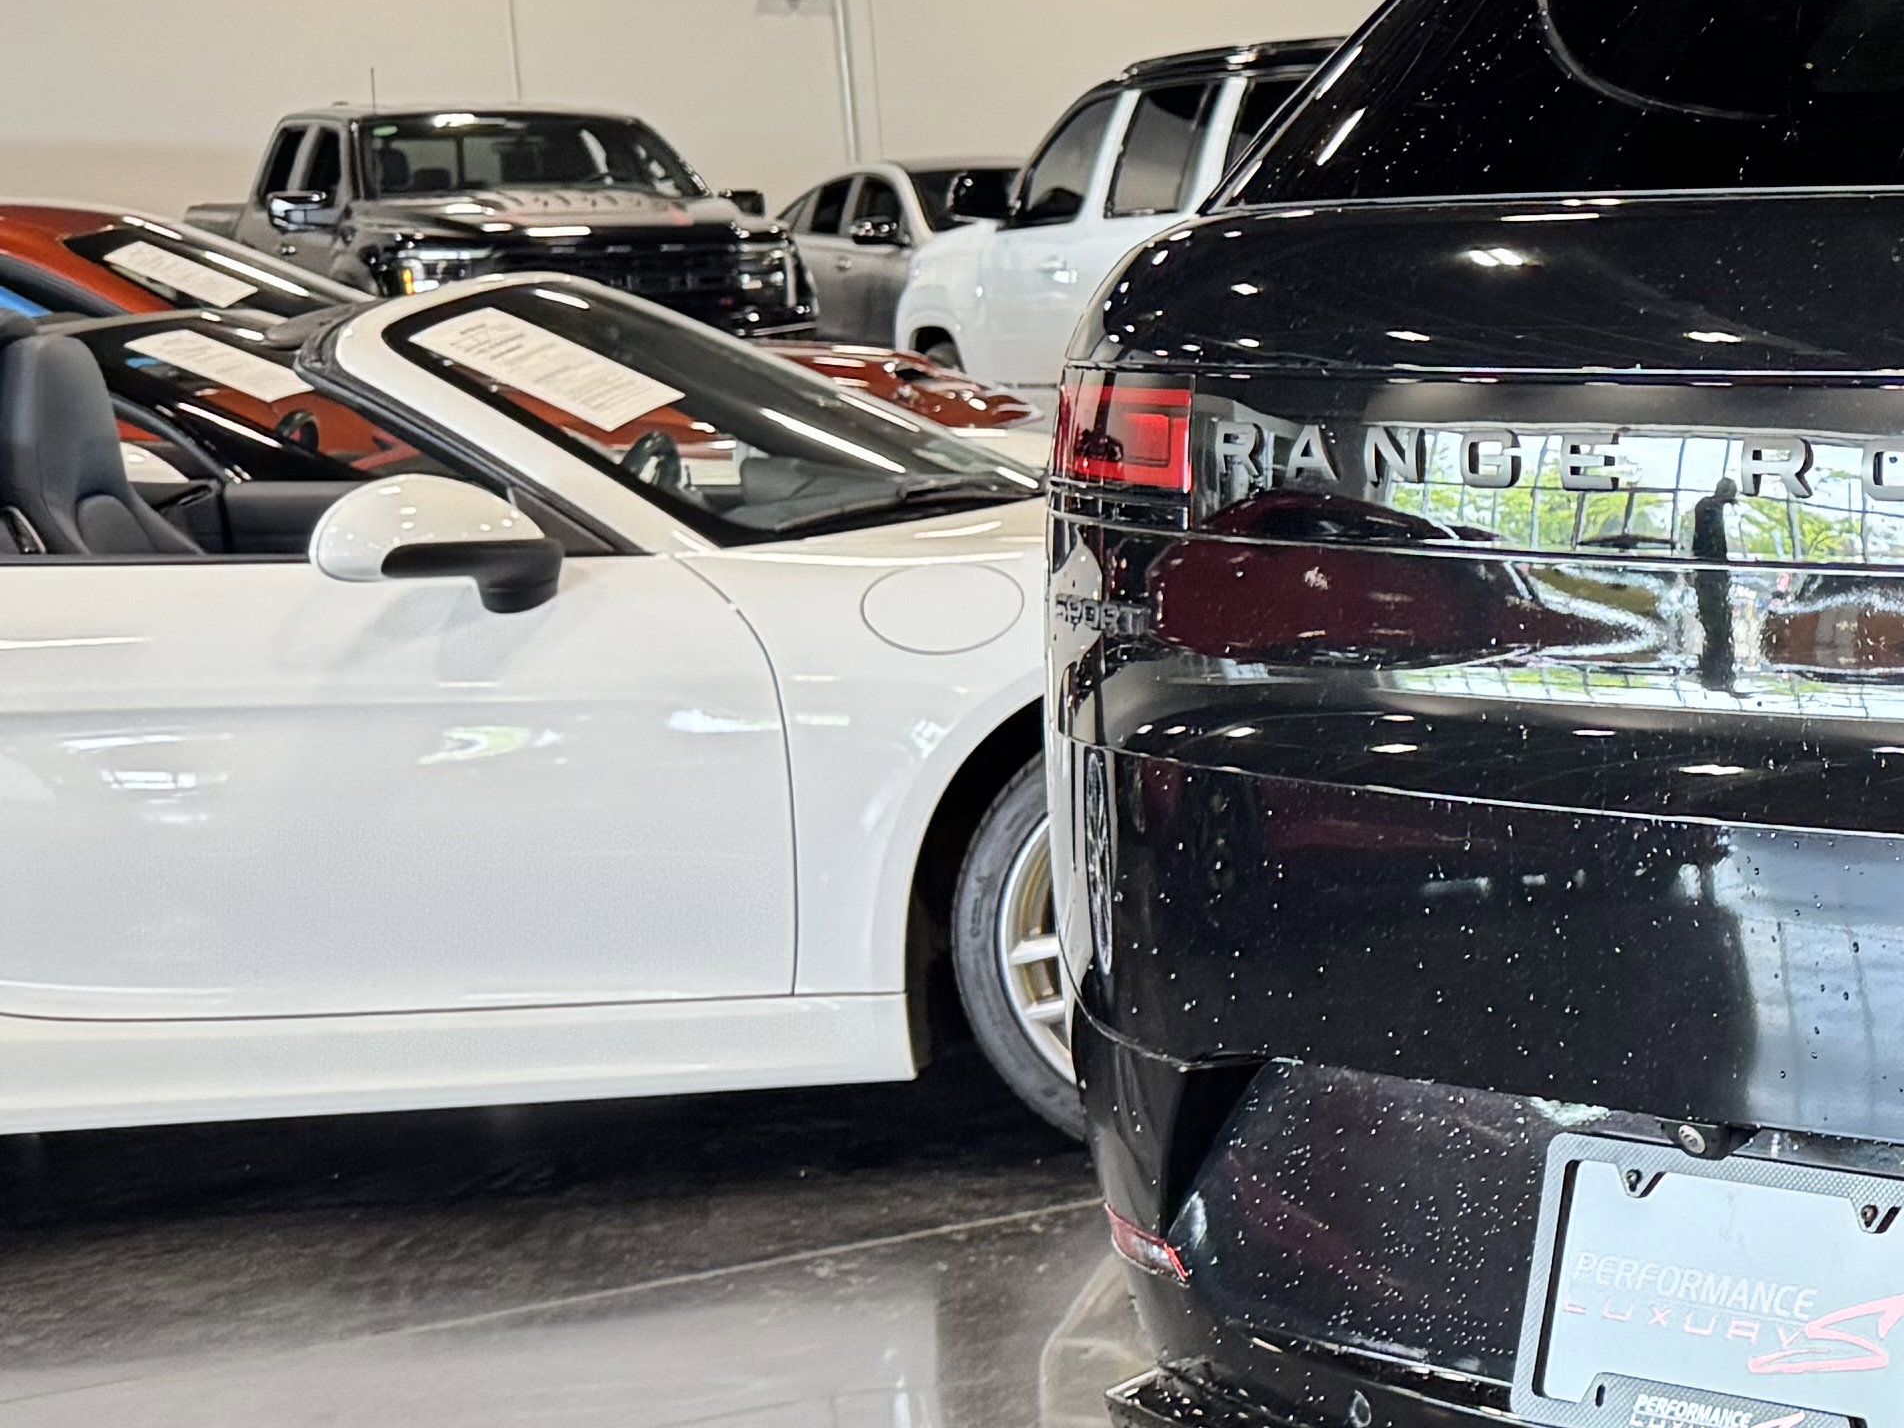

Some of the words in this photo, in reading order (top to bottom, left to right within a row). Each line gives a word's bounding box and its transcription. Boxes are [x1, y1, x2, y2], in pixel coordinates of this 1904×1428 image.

[1214, 420, 1622, 493] RANGE
[1574, 1252, 1818, 1319] PERFORMANCE
[1563, 1293, 1800, 1348] LUXURY
[1633, 1393, 1753, 1428] PERFORMANCE
